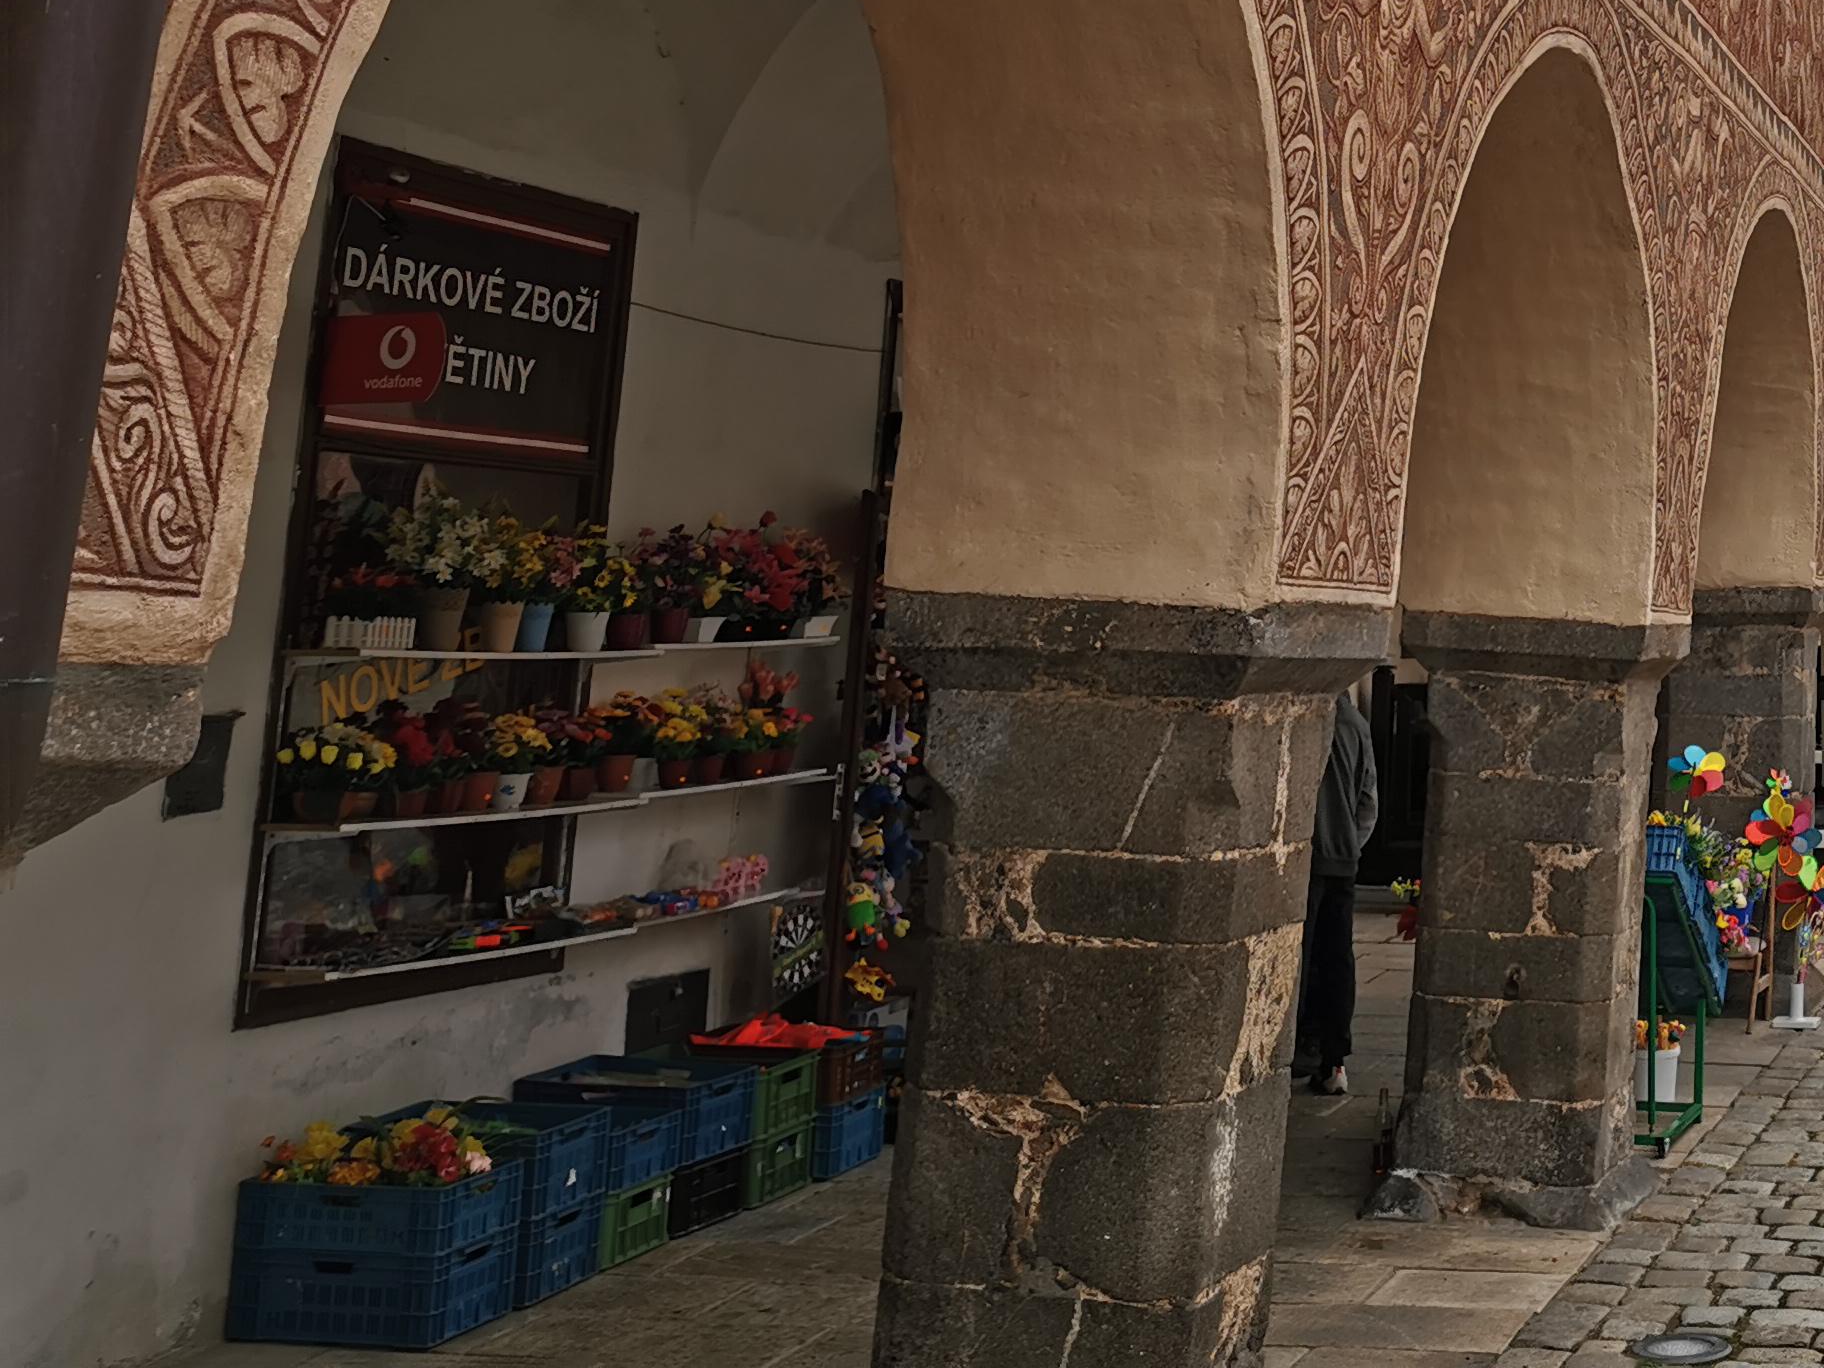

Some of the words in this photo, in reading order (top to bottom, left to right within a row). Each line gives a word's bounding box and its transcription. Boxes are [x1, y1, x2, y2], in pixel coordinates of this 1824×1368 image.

[343, 244, 505, 314] DÁRKOVÉ
[510, 281, 600, 333] ZBOŽÍ
[363, 374, 424, 390] vodafone
[444, 334, 537, 395] ĚTINY
